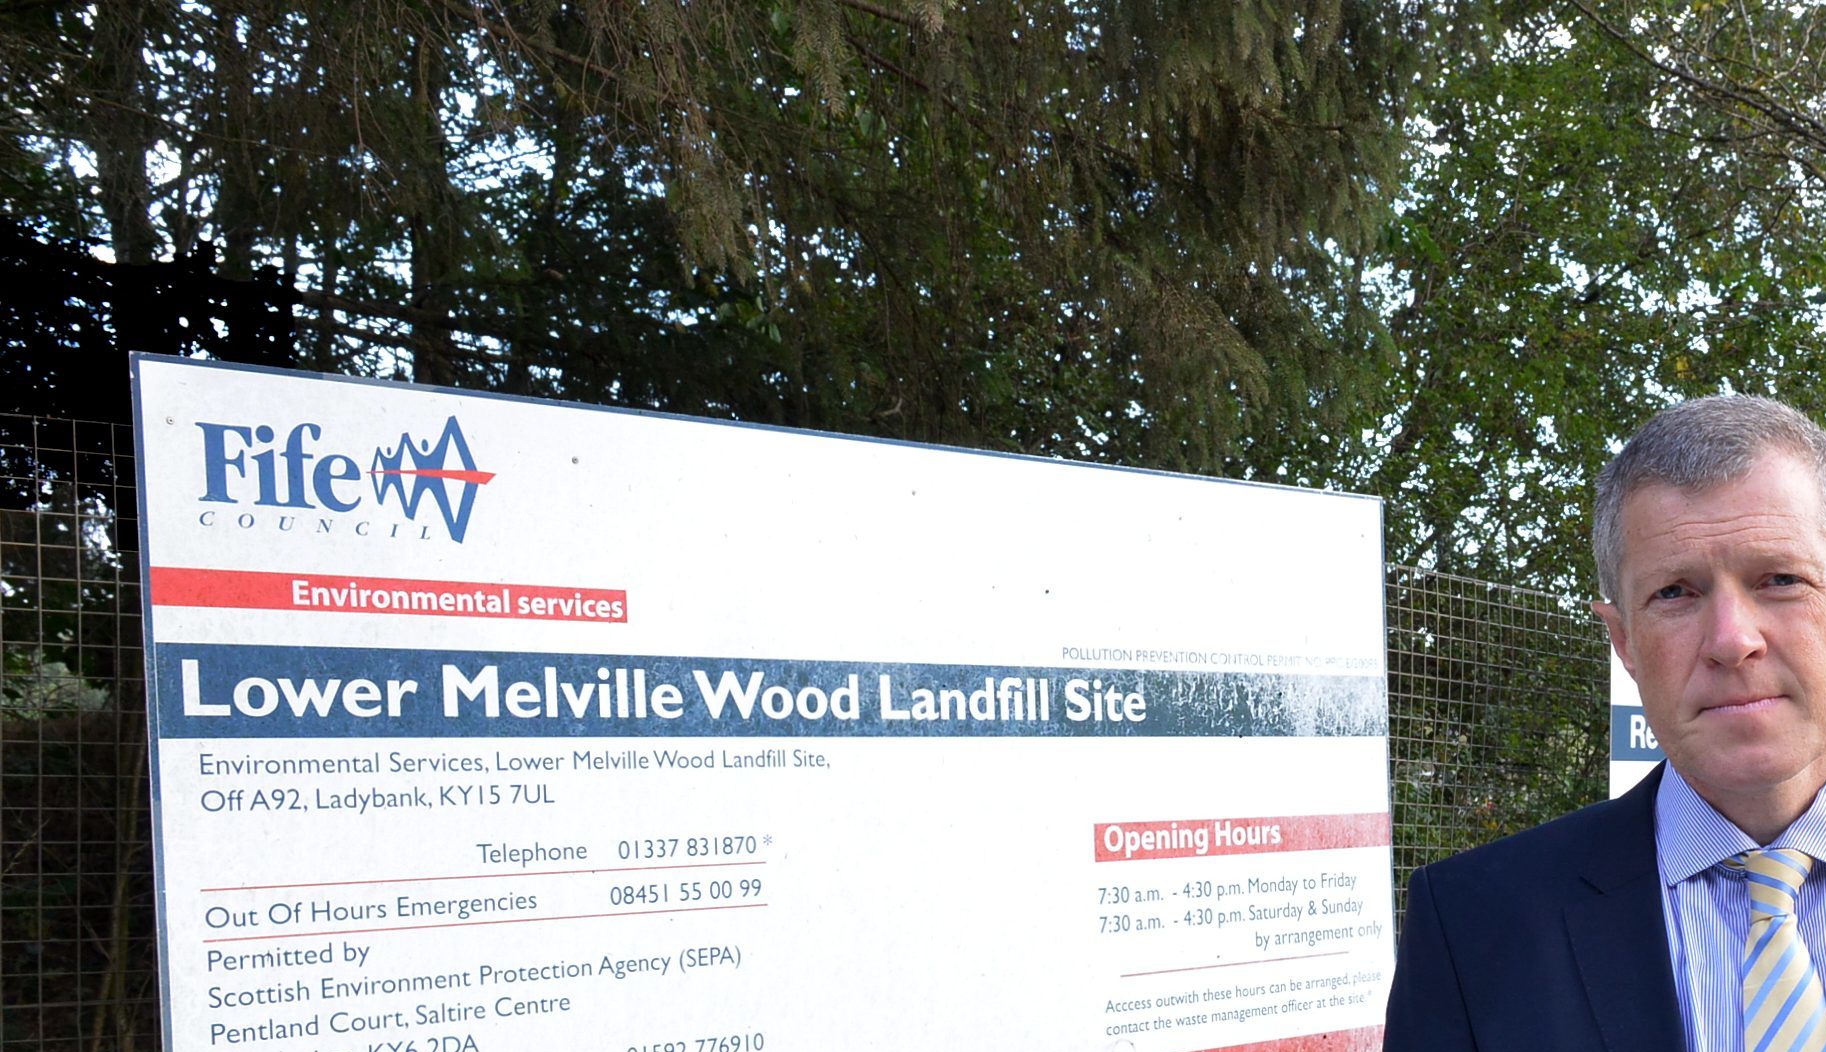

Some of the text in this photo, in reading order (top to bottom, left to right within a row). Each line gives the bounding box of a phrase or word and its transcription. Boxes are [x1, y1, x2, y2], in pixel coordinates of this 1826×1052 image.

[196, 421, 362, 513] Fife
[198, 511, 432, 541] COUNCIL
[292, 579, 624, 619] Environmental services
[1062, 647, 1133, 662] POLLUTION
[1136, 650, 1207, 664] PREVENTION
[1210, 652, 1264, 666] CONTROL
[181, 658, 1147, 723] Lower Melville Wood Landfill Site
[200, 748, 831, 776] Environmental Services, Lower Melville Wood Landfill Site,
[200, 784, 555, 814] Off A92, Ladybank, KY15 7UL
[476, 841, 588, 867] Telephone
[618, 836, 756, 859] 01337 831870
[1104, 821, 1281, 858] Opening Hours
[610, 879, 761, 905] 08451 55 00 99
[1099, 887, 1130, 904] 7:30
[1135, 888, 1164, 902] a.m.
[1183, 881, 1212, 898] 4:30
[1217, 883, 1244, 899] p.m.
[1248, 878, 1298, 896] Monday
[1303, 877, 1316, 890] to
[1321, 872, 1356, 890] Friday
[205, 889, 538, 930] Out Of Hours Emergencies
[1100, 916, 1130, 933] 7:30
[1136, 917, 1165, 930] a.m.
[1184, 908, 1212, 926] 4:30
[1218, 911, 1246, 927] p.m.
[1249, 904, 1303, 922] Saturday
[1308, 902, 1317, 915] &
[1322, 899, 1363, 916] Sunday
[1256, 921, 1382, 950] by arrangement only
[207, 942, 370, 973] Permitted by
[207, 945, 742, 1009] Scottish Environment Protection Agency (SEPA)
[1106, 970, 1381, 1013] Acccess outwith these hours can be arranged, please
[210, 993, 571, 1045] Pentland Court, Saltire Centre
[1106, 1020, 1149, 1036] contact
[1153, 1017, 1172, 1029] the
[1176, 1014, 1208, 1027] waste
[1212, 1006, 1278, 1022] management
[1282, 999, 1313, 1013] officer
[1317, 998, 1326, 1009] at
[1329, 994, 1345, 1007] the
